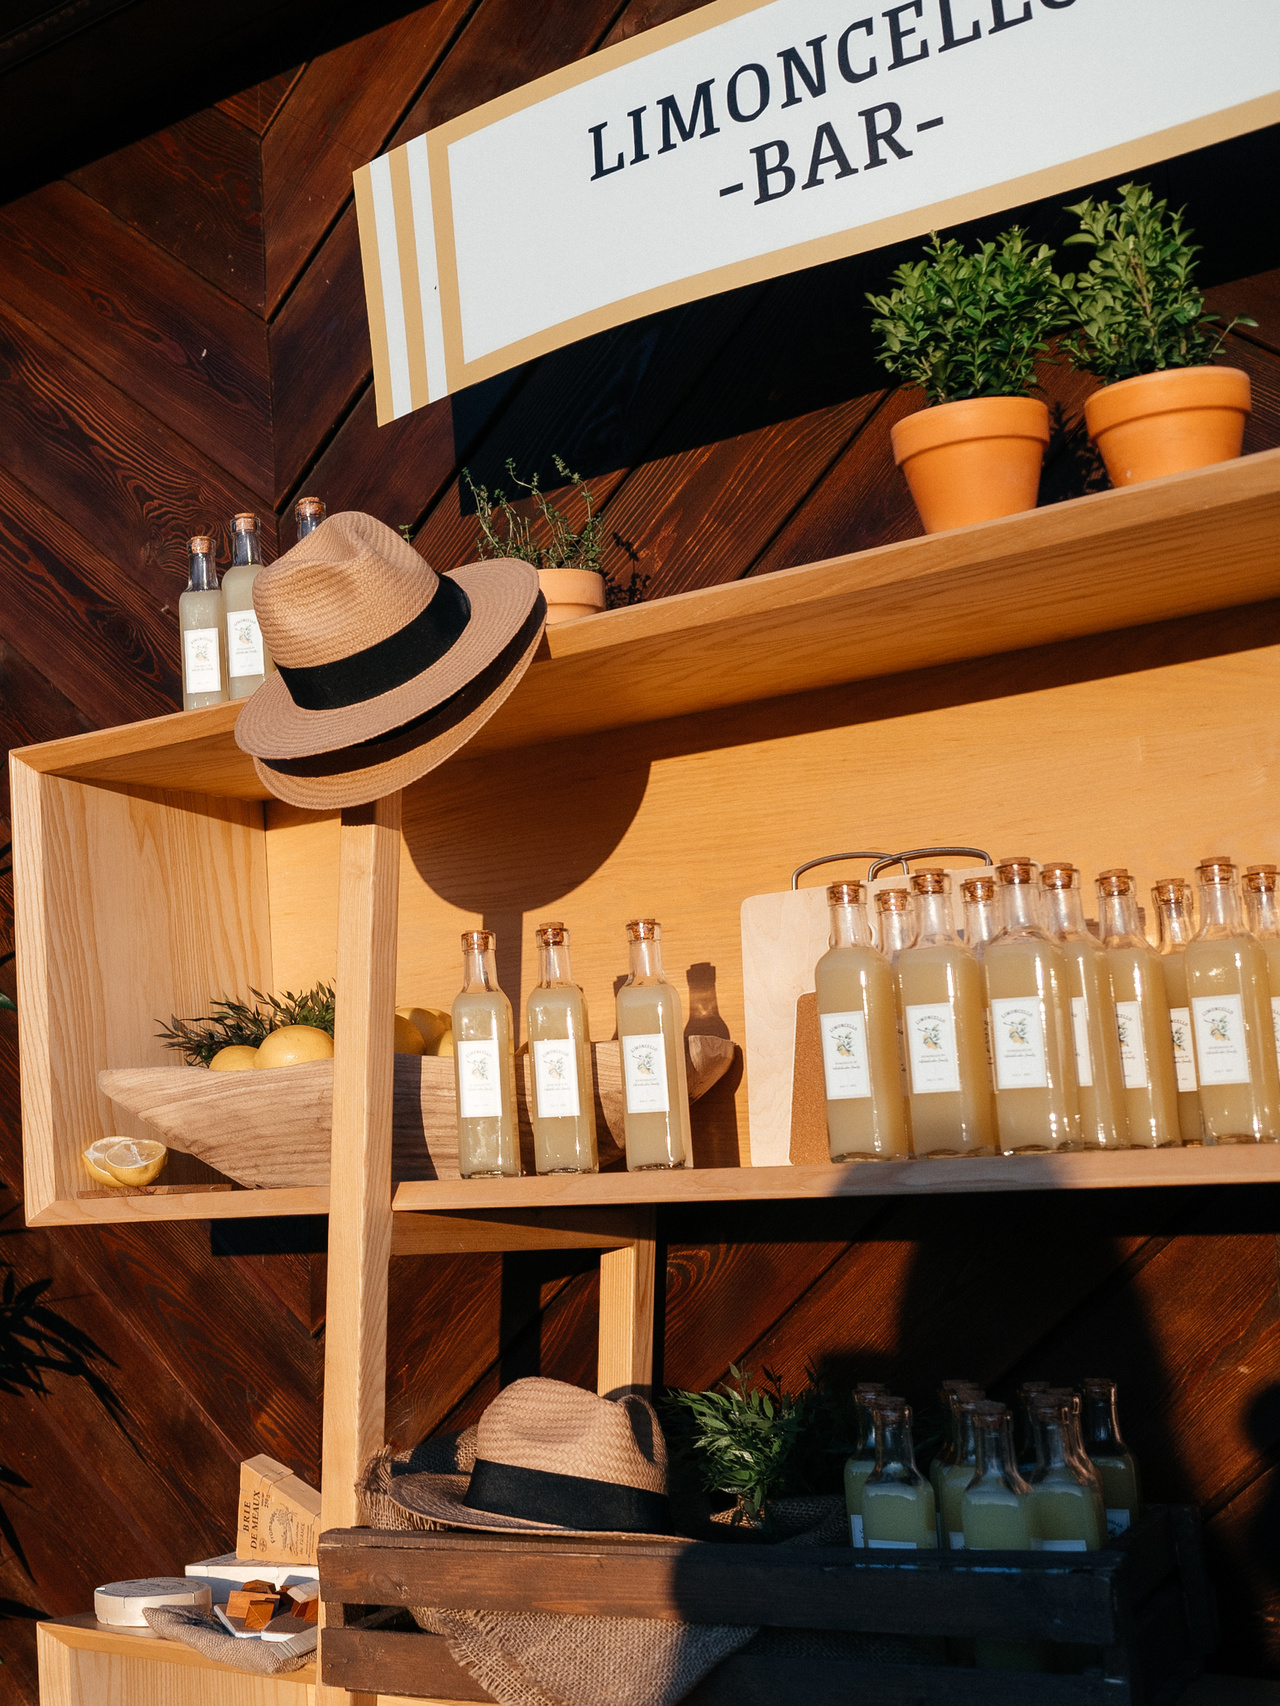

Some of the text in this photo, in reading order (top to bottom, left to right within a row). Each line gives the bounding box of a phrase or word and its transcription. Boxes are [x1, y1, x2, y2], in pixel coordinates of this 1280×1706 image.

[587, 0, 1077, 181] LIMONCELL
[719, 101, 944, 206] -BAR-
[243, 1501, 251, 1532] BRIE
[250, 1490, 261, 1550] DE MEAUX
